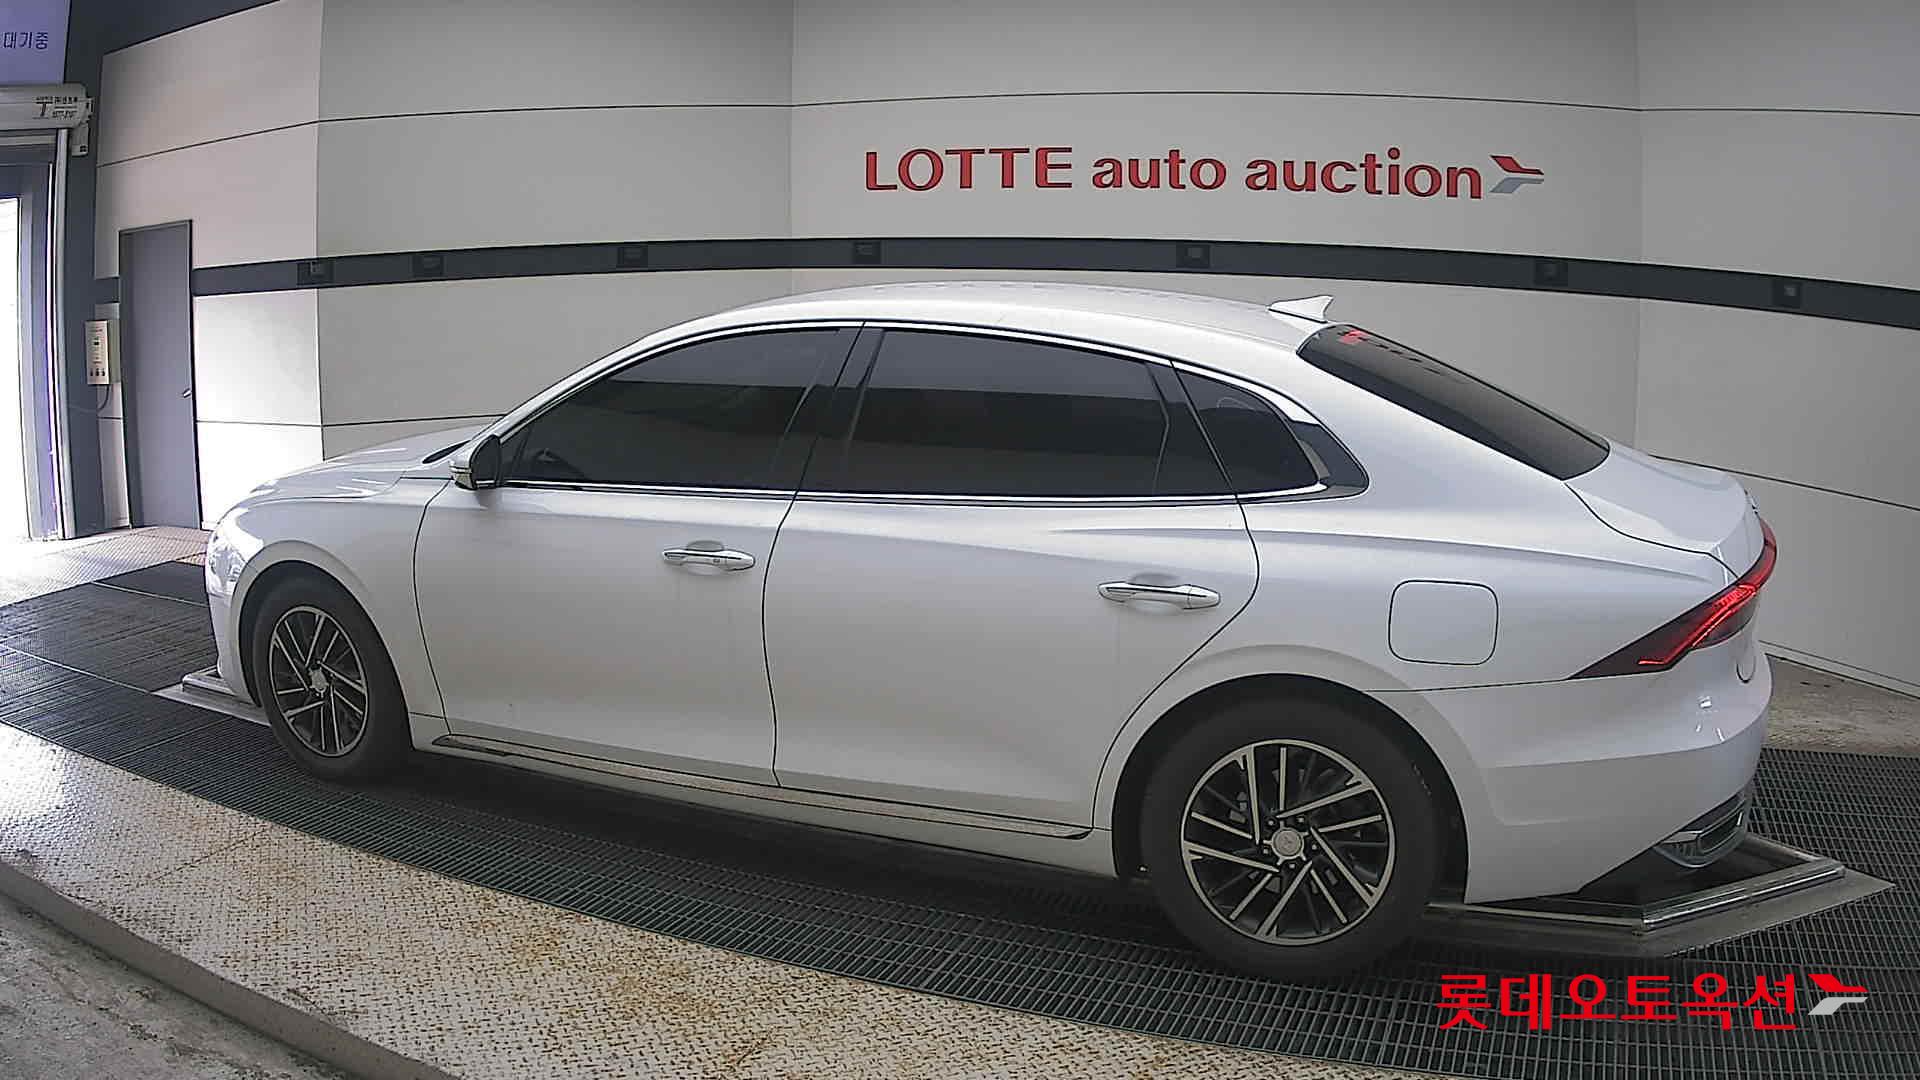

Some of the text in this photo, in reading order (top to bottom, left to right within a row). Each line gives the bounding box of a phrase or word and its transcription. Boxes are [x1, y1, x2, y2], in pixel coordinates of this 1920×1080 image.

[4, 31, 48, 50] 대기중
[865, 147, 1482, 199] LOTTE auto auction
